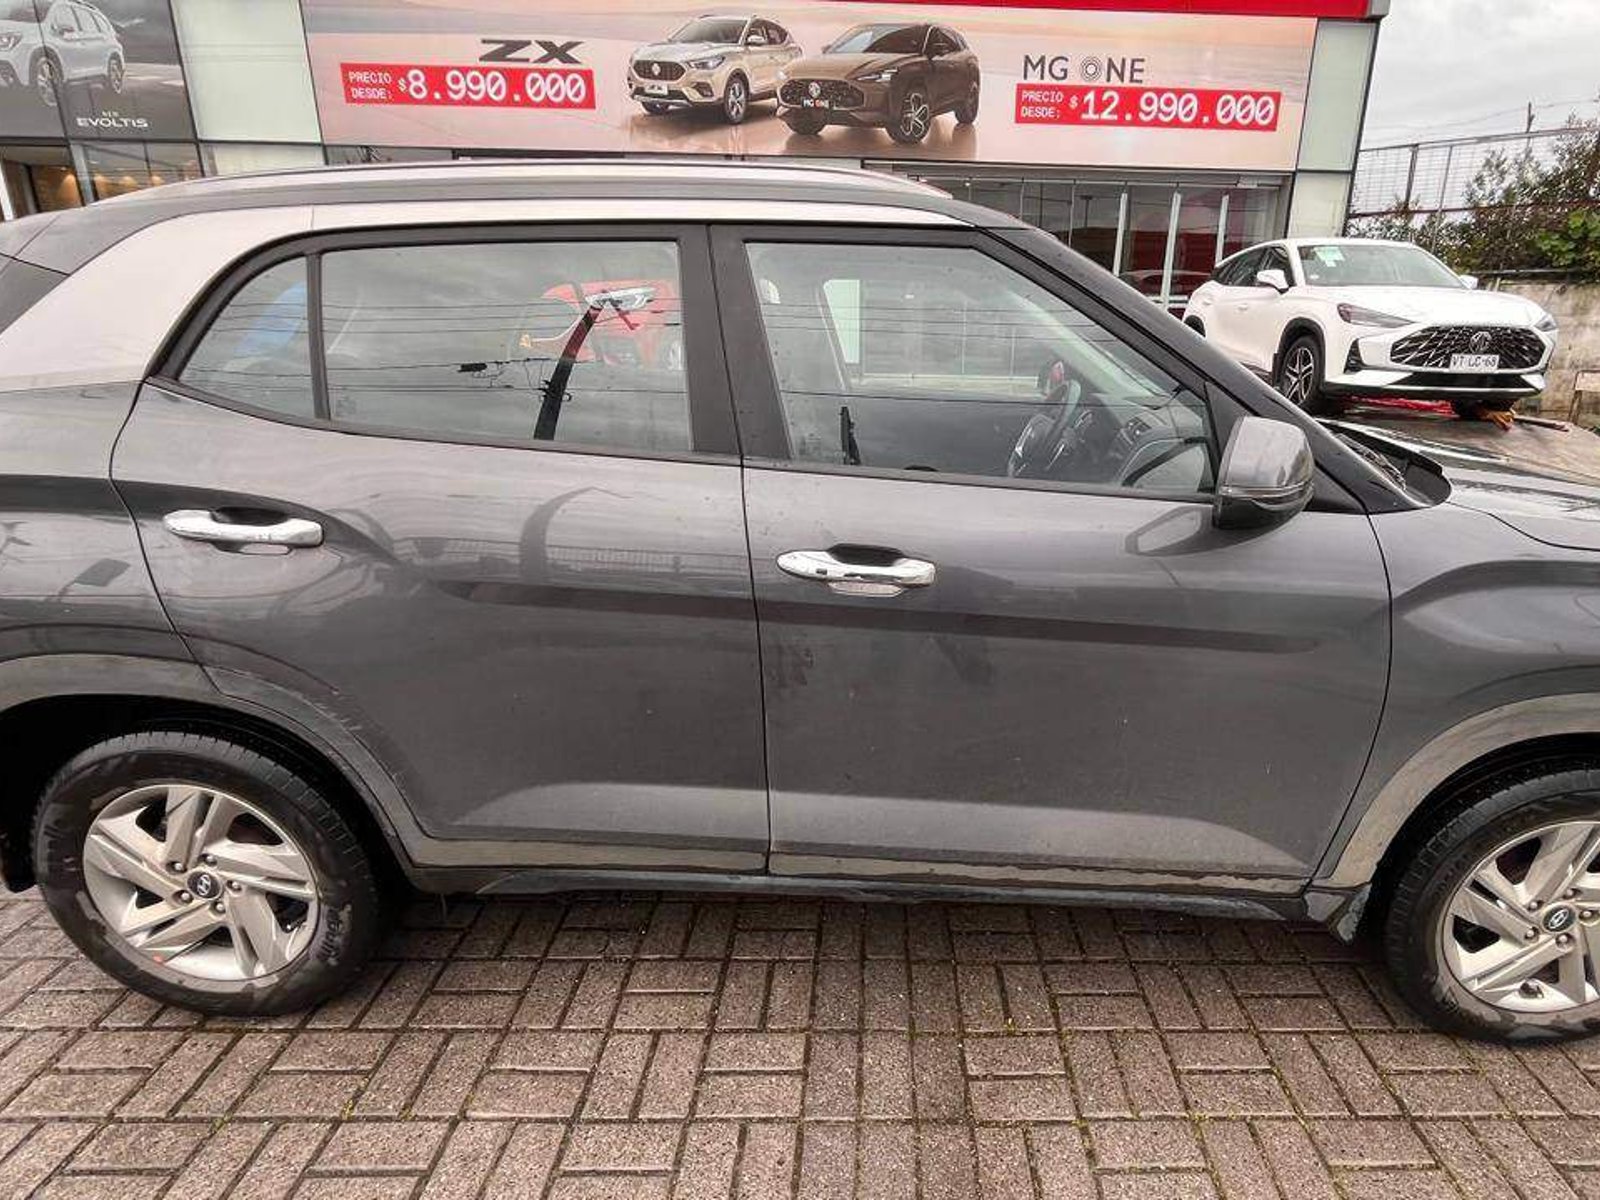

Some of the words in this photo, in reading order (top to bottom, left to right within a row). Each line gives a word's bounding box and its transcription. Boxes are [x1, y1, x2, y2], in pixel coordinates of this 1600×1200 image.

[479, 39, 584, 64] ZX
[1023, 54, 1069, 81] MG
[1080, 55, 1145, 83] ONE
[348, 71, 392, 84] PRECIO
[398, 68, 586, 103] $8.990.000
[351, 87, 393, 100] DESDE:
[1021, 90, 1064, 103] PRECIO
[1020, 106, 1061, 118] DESDE:
[1068, 90, 1275, 125] $12.990.000
[76, 117, 148, 127] EVOLTIS
